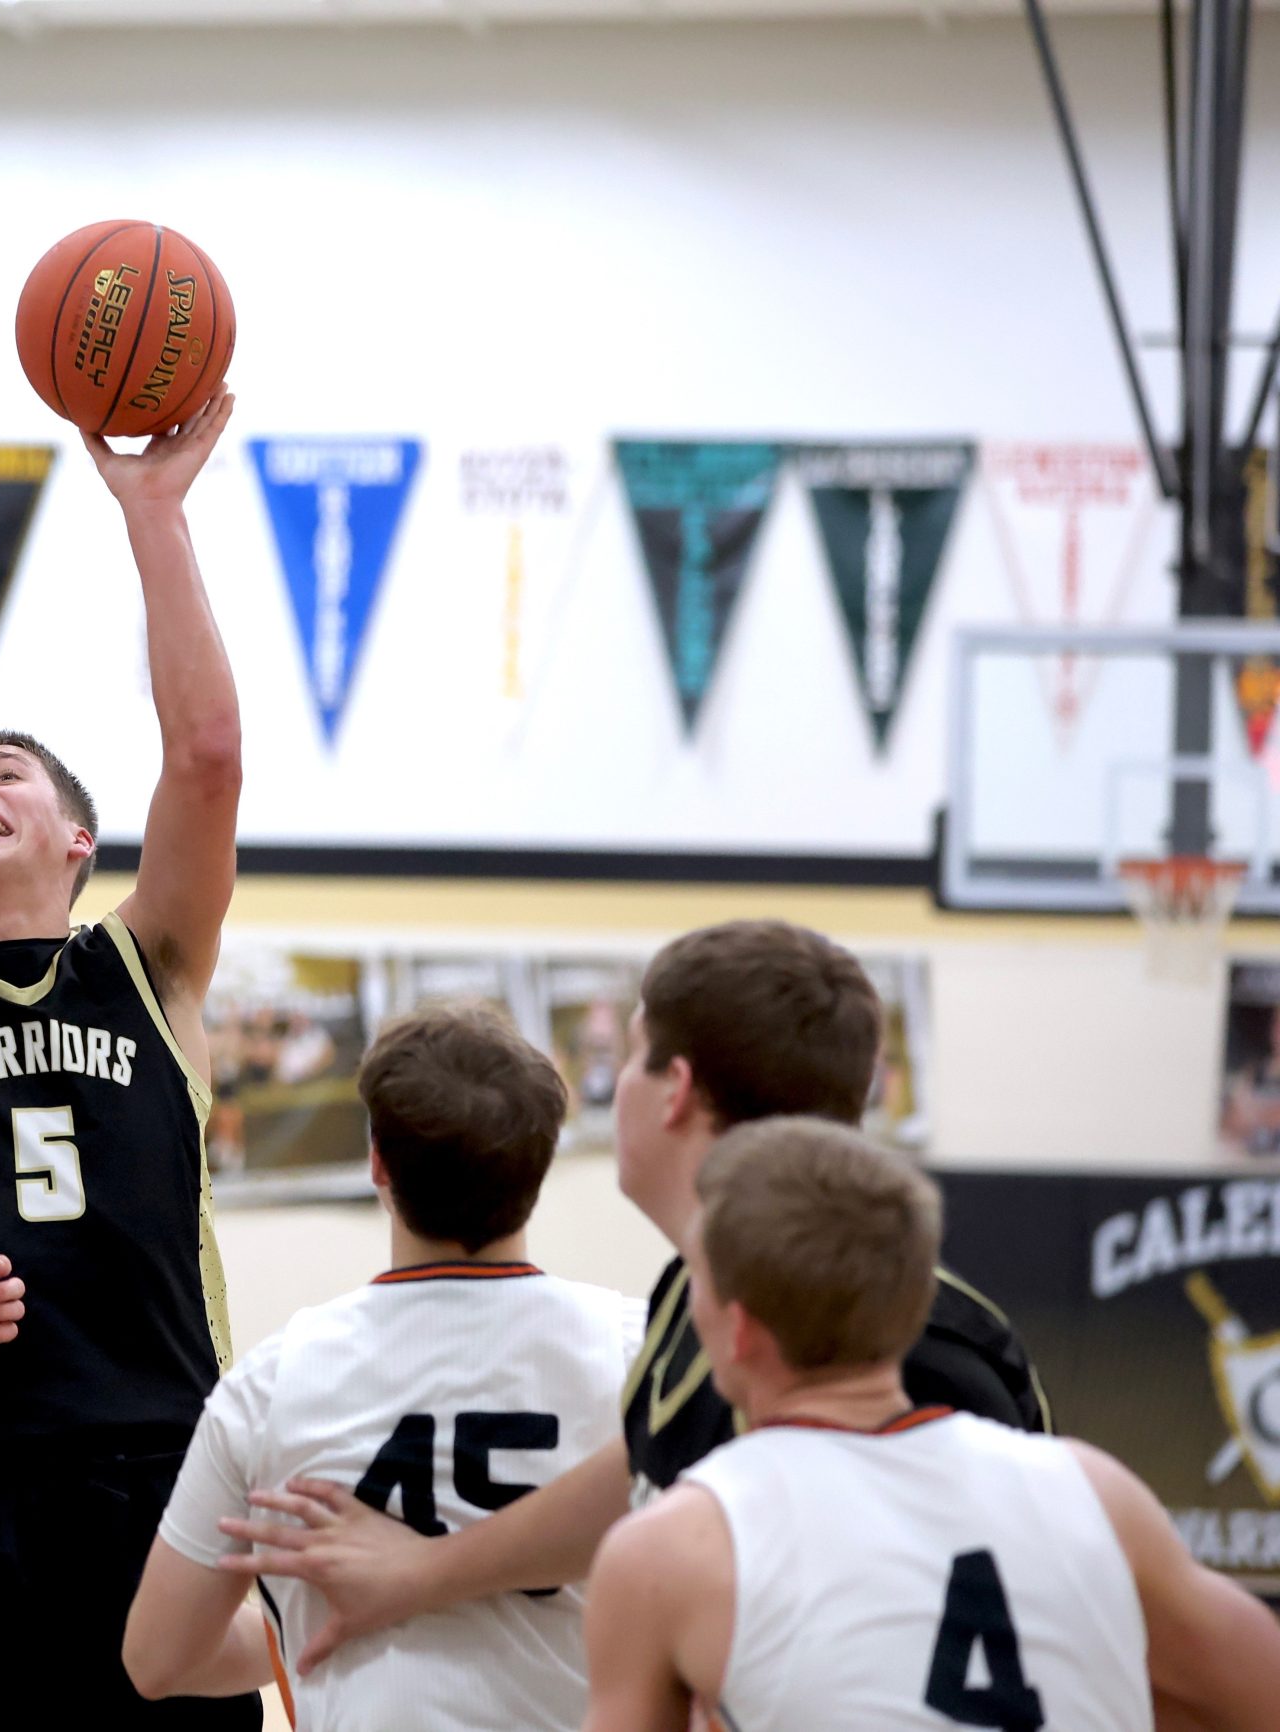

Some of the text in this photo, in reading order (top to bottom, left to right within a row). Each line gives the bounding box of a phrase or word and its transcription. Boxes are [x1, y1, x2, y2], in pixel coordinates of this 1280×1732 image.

[74, 295, 102, 372] 1000
[87, 263, 140, 388] LEGACY
[128, 269, 197, 412] SPALDING
[10, 1105, 86, 1223] 5
[1090, 1179, 1280, 1298] CALE
[924, 1548, 1045, 1732] 4
